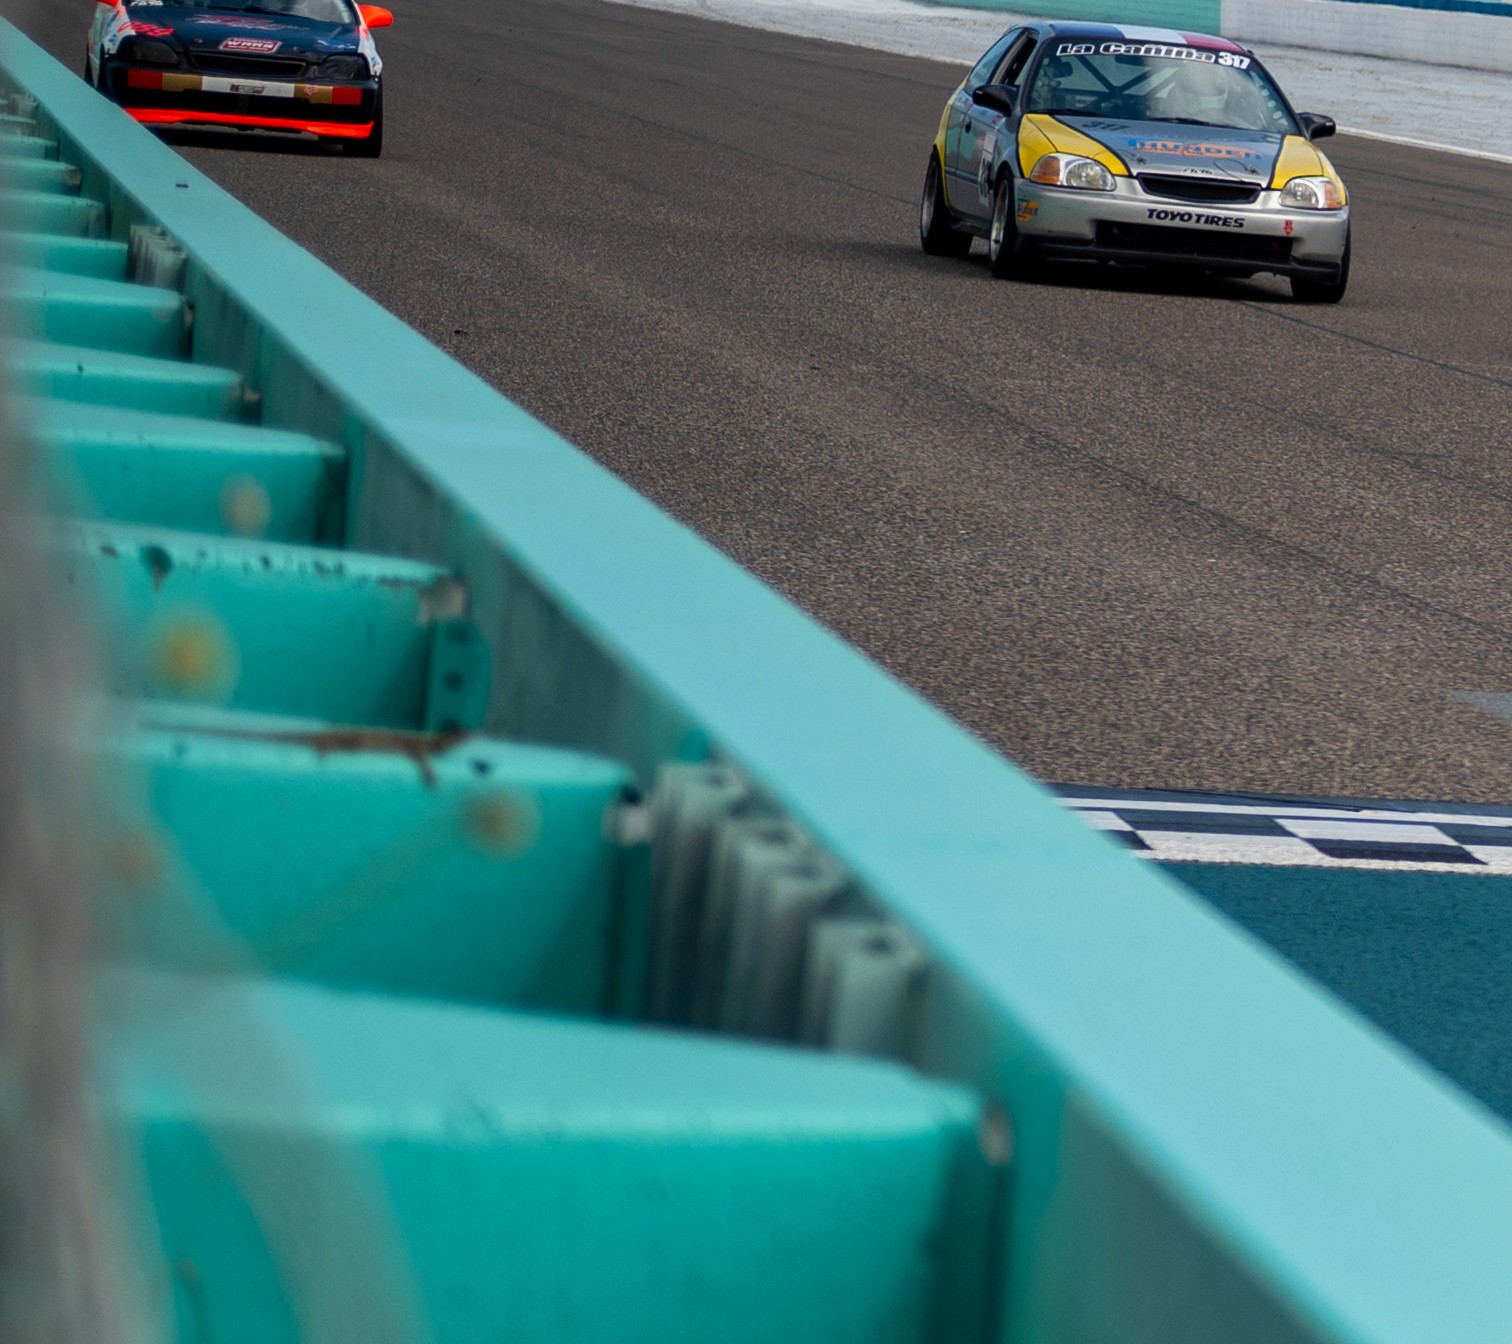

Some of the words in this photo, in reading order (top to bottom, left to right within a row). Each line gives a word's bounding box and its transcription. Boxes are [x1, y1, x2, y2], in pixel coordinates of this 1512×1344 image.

[1056, 43, 1095, 56] La
[1218, 51, 1251, 70] 317
[1082, 121, 1130, 132] 317
[1146, 208, 1193, 223] TOYO
[1194, 212, 1245, 229] TIRES
